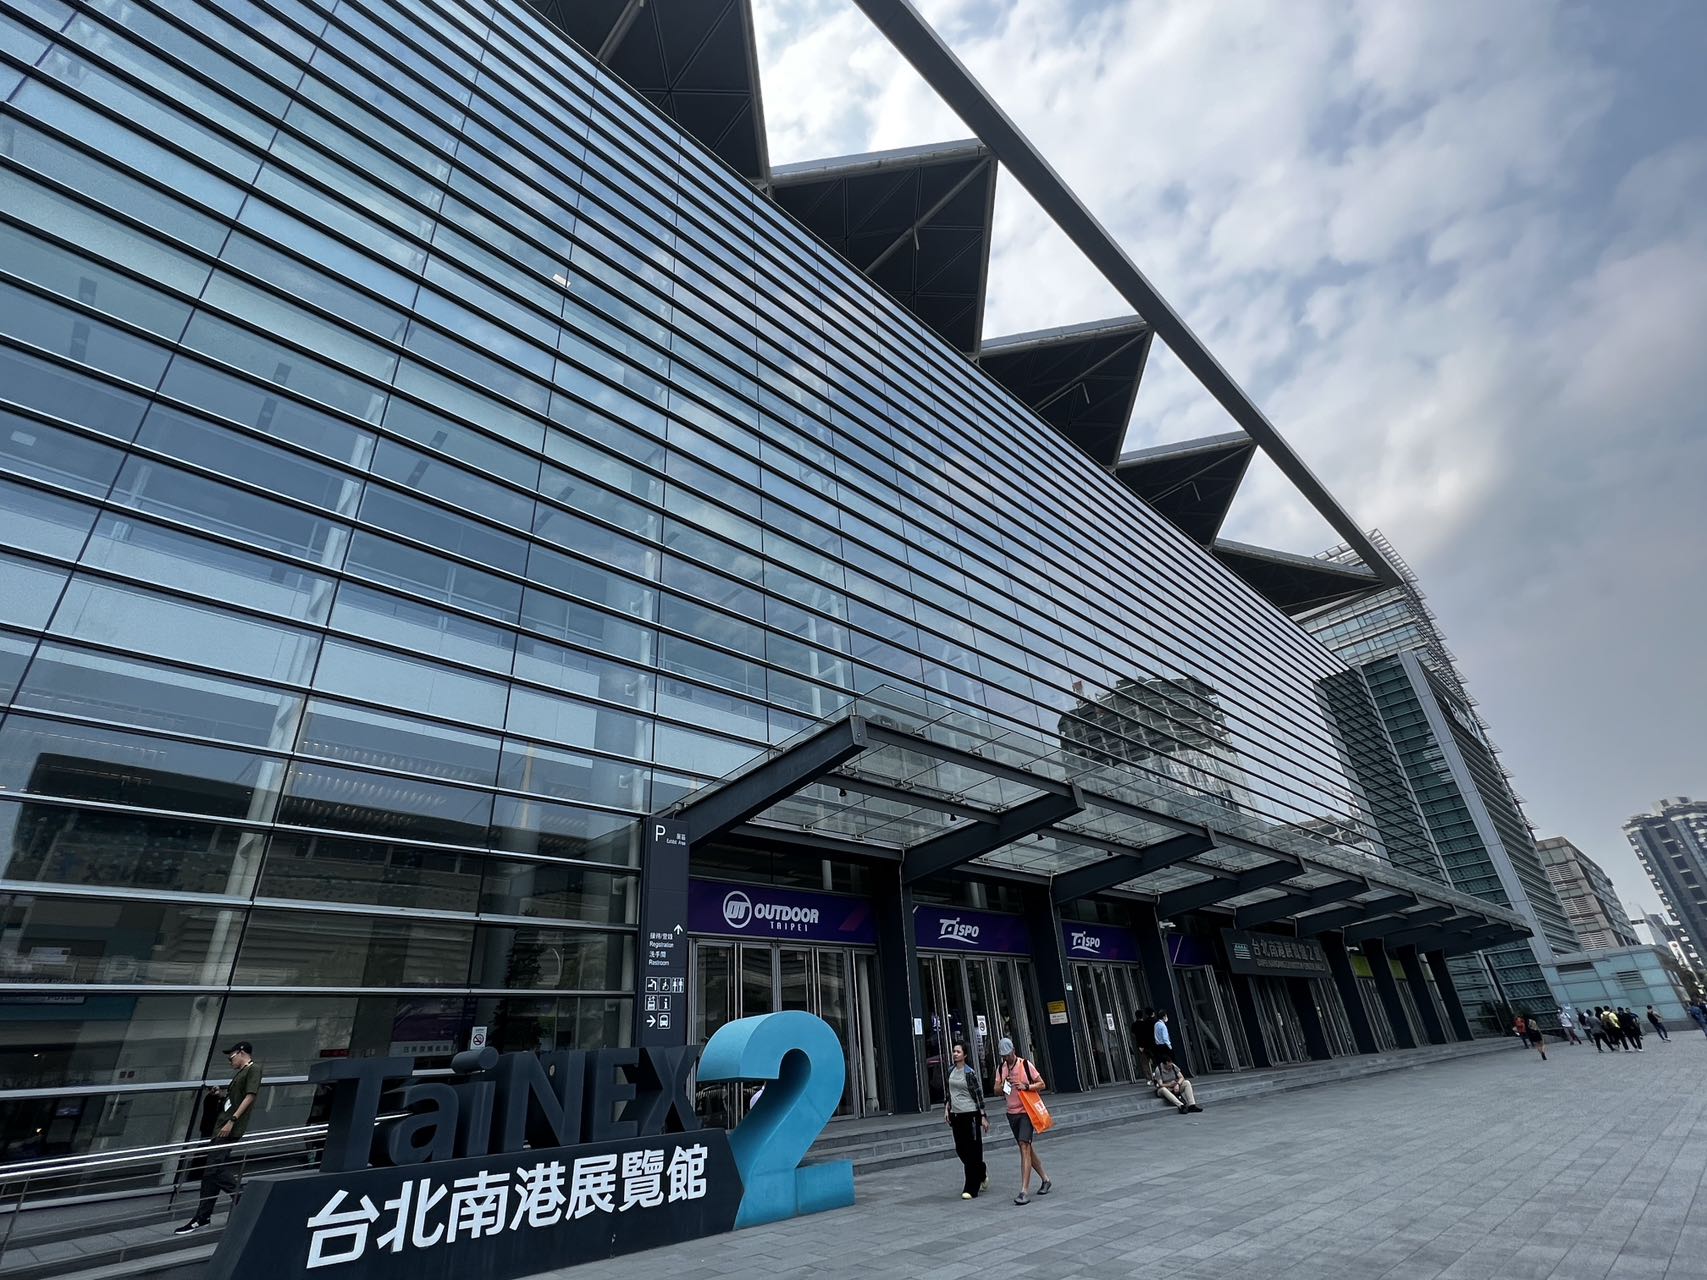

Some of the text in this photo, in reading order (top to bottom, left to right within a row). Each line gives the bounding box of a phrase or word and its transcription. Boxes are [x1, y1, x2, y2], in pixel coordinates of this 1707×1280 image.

[655, 824, 666, 842] P
[754, 903, 820, 924] OUTDOOR
[769, 921, 808, 932] TAIPEI
[308, 1010, 856, 1231] TaiNEX 2
[306, 1143, 708, 1270] 台北南港展覽館
